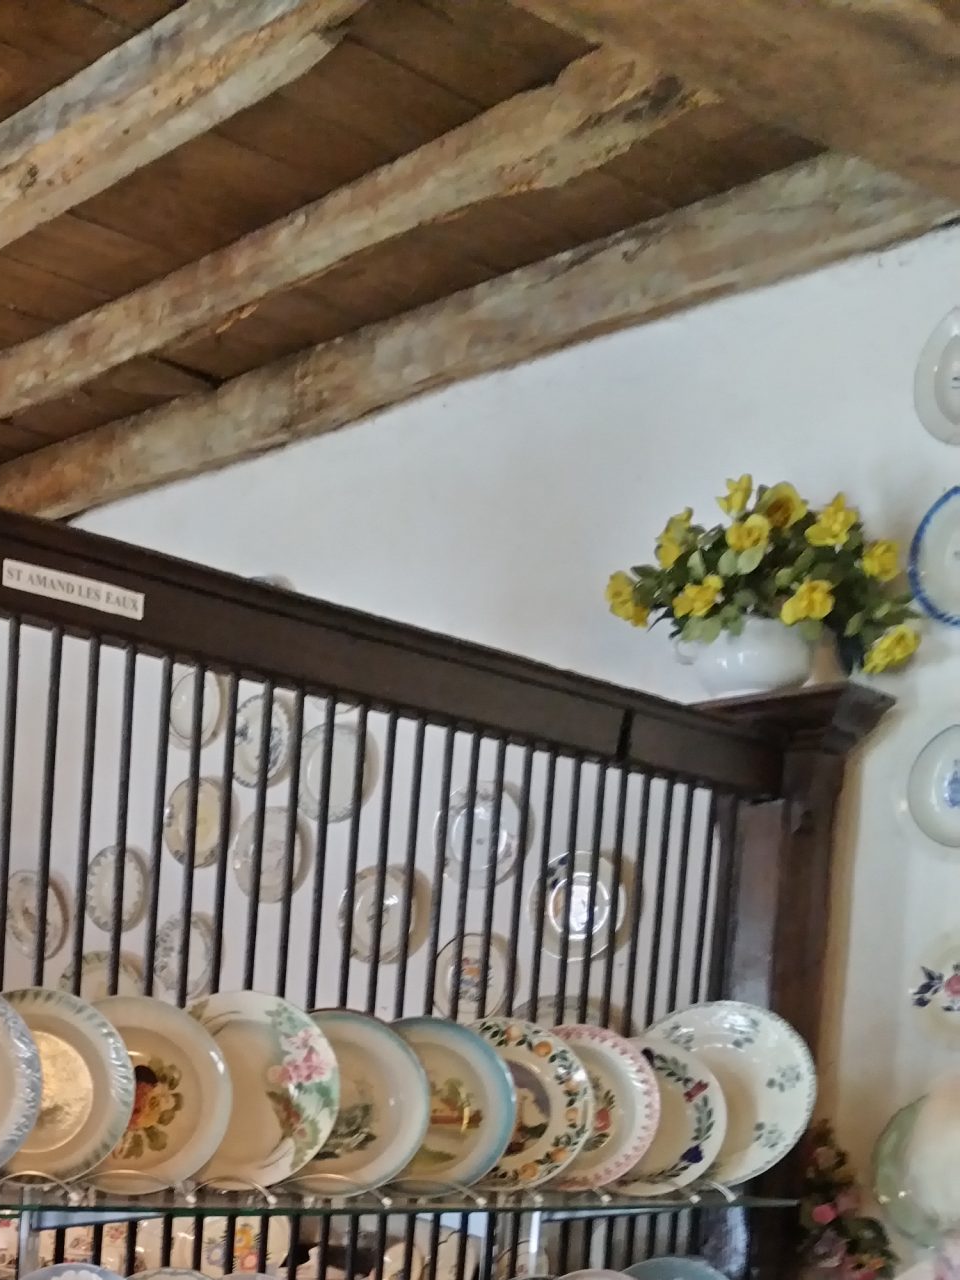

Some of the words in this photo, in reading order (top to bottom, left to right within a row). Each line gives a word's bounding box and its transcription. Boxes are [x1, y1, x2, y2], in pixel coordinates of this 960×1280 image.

[6, 567, 23, 582] ST
[27, 573, 75, 595] AMAND
[77, 584, 101, 602] LES
[105, 591, 139, 612] EAUX
